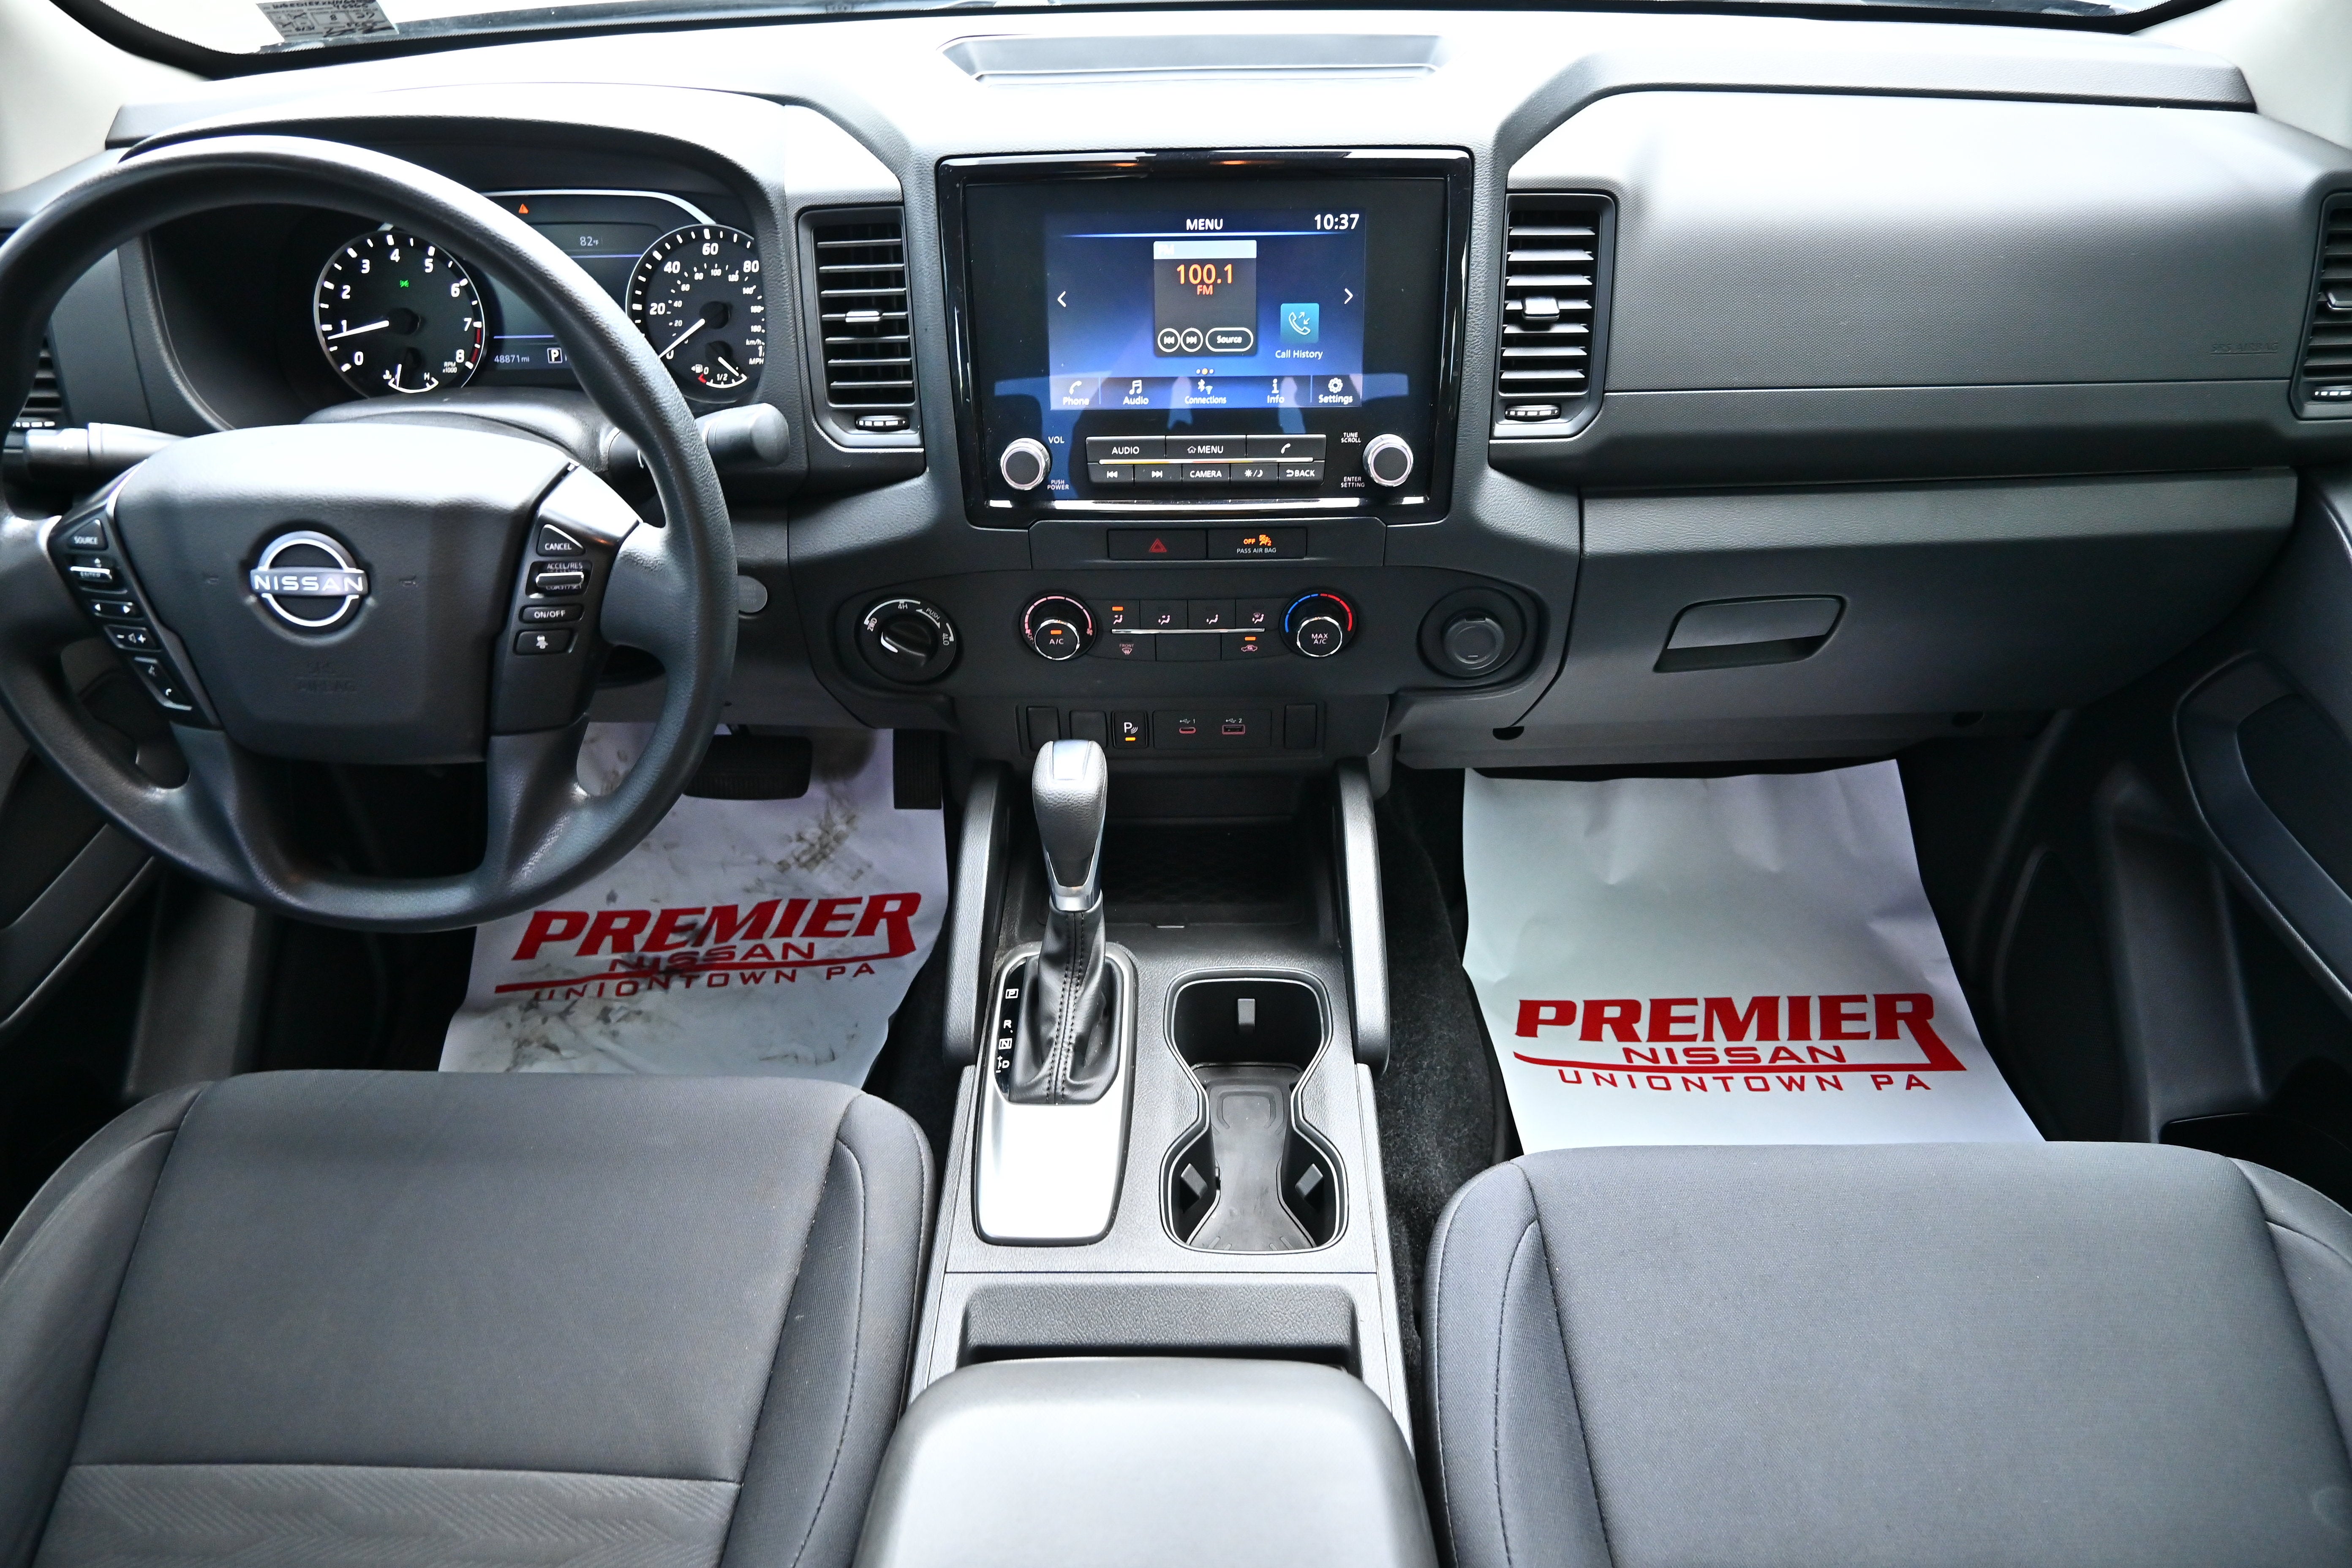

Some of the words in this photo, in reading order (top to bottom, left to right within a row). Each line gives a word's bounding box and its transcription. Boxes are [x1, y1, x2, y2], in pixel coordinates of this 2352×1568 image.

[1186, 218, 1223, 231] MENU
[1314, 214, 1359, 230] 10:37
[390, 248, 400, 262] 4
[702, 243, 718, 255] 60
[1158, 244, 1175, 256] FM
[361, 259, 370, 273] 3
[425, 258, 433, 273] 5
[664, 261, 681, 273] 40
[743, 260, 760, 272] 80
[728, 274, 739, 282] 120
[1176, 264, 1233, 284] 100.1
[341, 285, 351, 299] 2
[451, 283, 460, 297] 6
[681, 283, 690, 291] 60
[1197, 284, 1213, 295] FM
[649, 302, 666, 315] 20
[341, 319, 347, 332] 1
[464, 318, 472, 331] 7
[1216, 335, 1243, 344] Source
[354, 351, 364, 365] 0
[456, 349, 465, 363] 8
[550, 349, 559, 362] P
[1275, 350, 1291, 359] Call
[1293, 349, 1323, 360] History
[703, 366, 709, 375] 0
[1063, 396, 1090, 406] Phone
[1123, 395, 1149, 406] Audio
[1184, 395, 1227, 405] Connections
[1267, 394, 1285, 404] Info
[1318, 394, 1353, 405] Settings
[1048, 436, 1065, 444] VOL
[1111, 446, 1140, 455] AUDIO
[1197, 445, 1224, 454] MENU
[1190, 470, 1222, 478] CAMERA
[1295, 469, 1315, 477] BACK
[74, 536, 98, 545] SOURCE
[544, 542, 572, 550] CANCEL
[547, 561, 583, 570] ACCEL/RES
[254, 574, 364, 591] NISSAN
[534, 610, 566, 619] ON/OFF
[926, 607, 941, 621] PUSH
[1124, 722, 1132, 734] P
[512, 891, 922, 961] PREMIER
[608, 942, 815, 973] NISSAN
[532, 968, 797, 1002] UNIONTOWN
[825, 962, 875, 982] PA
[1003, 1019, 1012, 1029] R
[1514, 993, 1960, 1060] PREMIER
[1625, 1045, 1848, 1065] NISSAN
[1002, 1060, 1010, 1069] D
[1557, 1068, 1844, 1092] UNIONTOWN
[1870, 1073, 1932, 1092] PA
